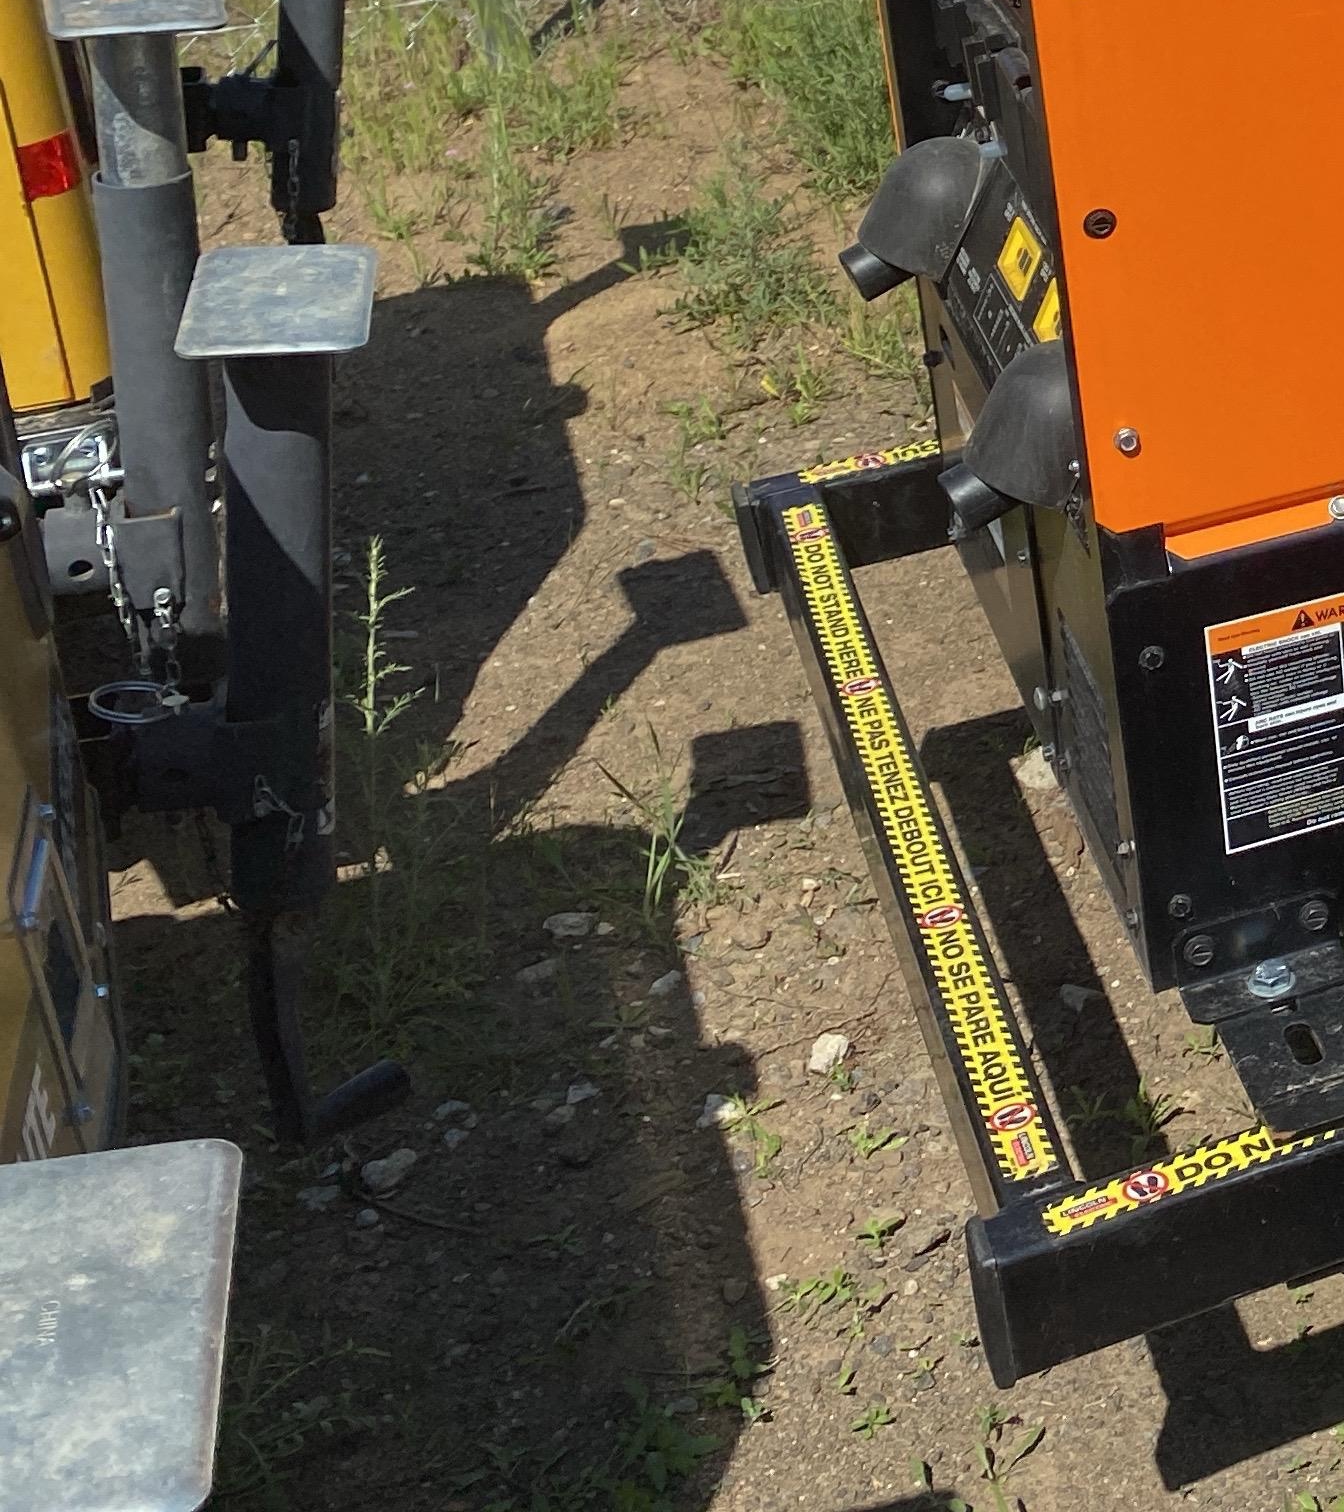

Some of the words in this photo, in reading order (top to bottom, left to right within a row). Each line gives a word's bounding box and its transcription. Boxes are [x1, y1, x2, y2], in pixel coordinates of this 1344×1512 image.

[804, 544, 825, 563] DO
[811, 565, 834, 590] NOT
[819, 593, 849, 638] STAND
[835, 640, 864, 679] HERE
[855, 696, 879, 720] NE
[865, 719, 890, 751] PAS
[874, 751, 910, 805] TENEZ
[893, 805, 936, 875] DEBOUT
[918, 878, 946, 905] ICI
[936, 929, 965, 959] NO
[948, 962, 976, 990] SE
[957, 990, 996, 1047] PARE
[1175, 1152, 1233, 1181] DO
